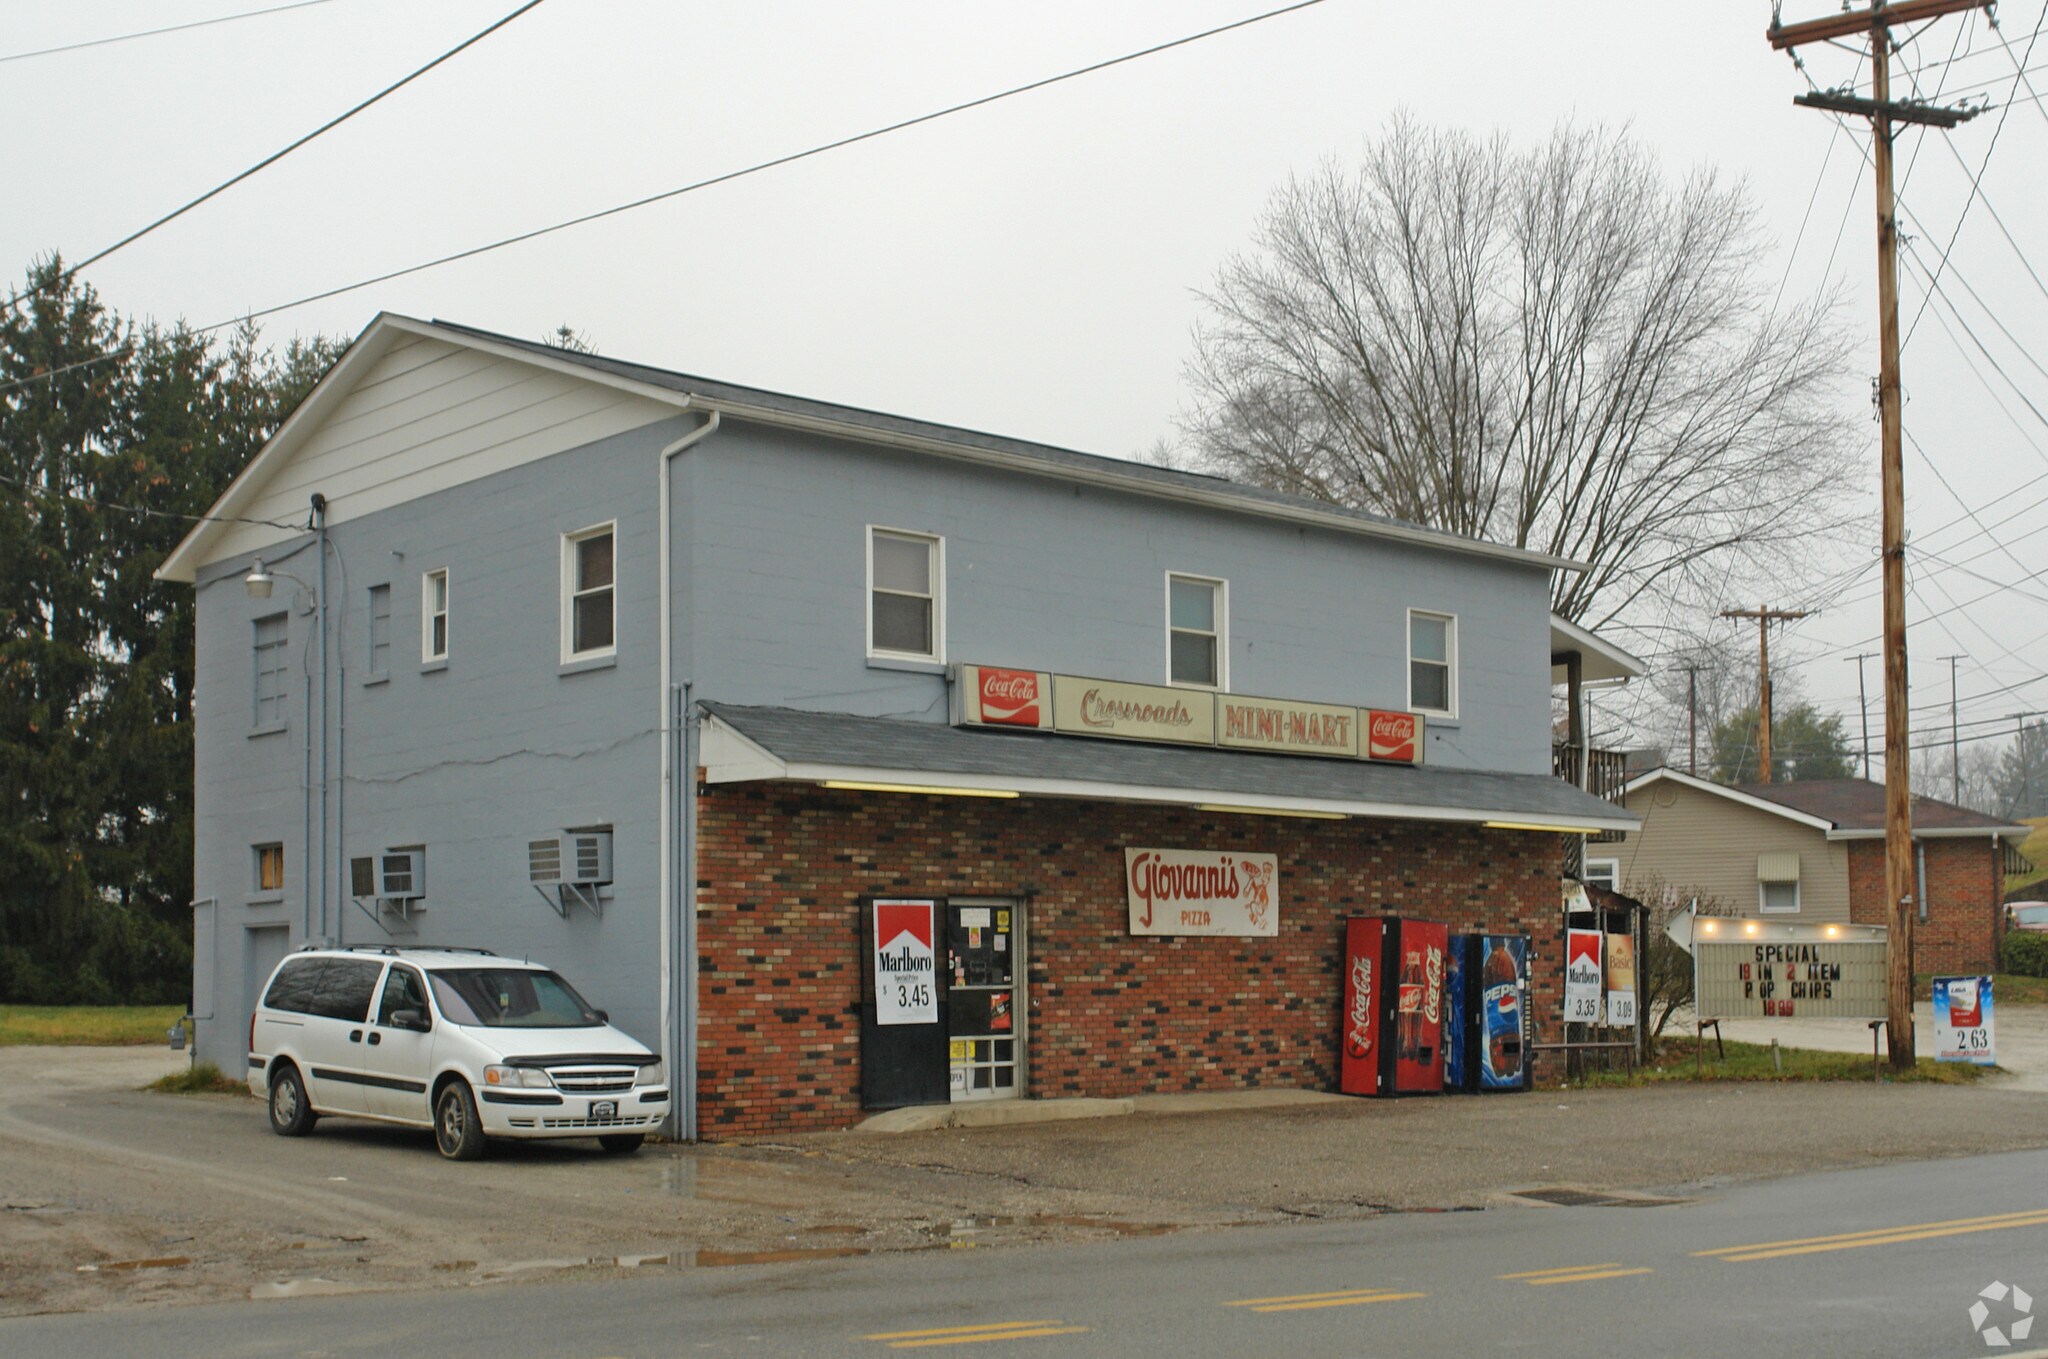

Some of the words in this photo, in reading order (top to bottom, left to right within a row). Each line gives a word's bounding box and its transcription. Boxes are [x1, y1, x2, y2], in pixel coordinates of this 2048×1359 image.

[1080, 688, 1193, 728] Crossroads
[1226, 704, 1350, 747] MINI-MART
[1131, 852, 1240, 928] Giovanni's
[1180, 910, 1211, 926] PIZZA
[879, 946, 932, 973] Marlboro
[1609, 955, 1632, 969] Basic
[1755, 945, 1819, 962] SPECIAL
[1569, 964, 1600, 985] Marlboro
[1758, 963, 1772, 981] IN
[1786, 962, 1796, 981] 2
[1808, 963, 1840, 981] ITEM
[1350, 955, 1372, 1028] Coca-Cola
[1424, 943, 1442, 1025] Coca-Cola
[1791, 982, 1832, 999] CHIPS
[898, 984, 929, 1008] 3.45
[1576, 998, 1595, 1016] 3.35
[1616, 1000, 1632, 1018] 3.09
